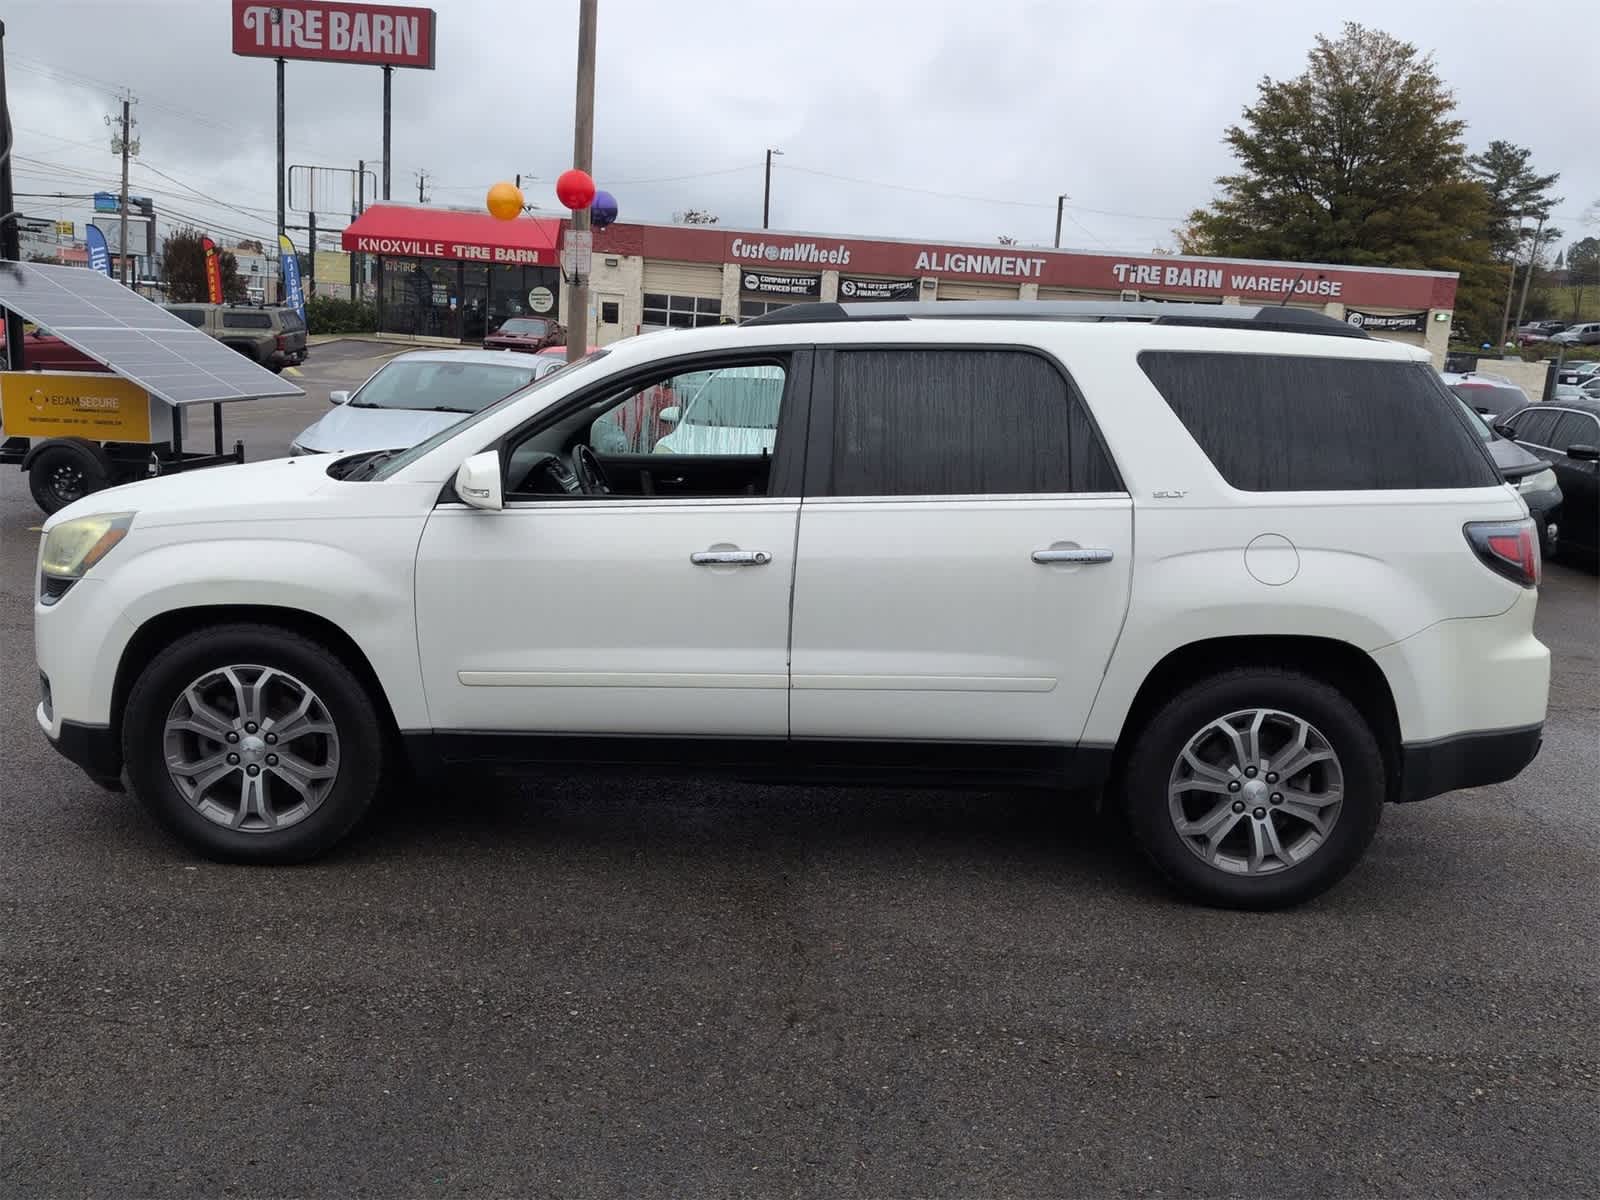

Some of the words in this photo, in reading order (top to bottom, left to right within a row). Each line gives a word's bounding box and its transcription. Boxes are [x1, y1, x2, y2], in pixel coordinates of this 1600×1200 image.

[329, 11, 419, 56] BARN
[358, 237, 444, 256] KNOXVILLE
[495, 247, 539, 263] BARN
[914, 251, 1047, 277] ALIGNMENT
[760, 275, 791, 284] COMPANY
[760, 284, 791, 292] SERVICED
[1165, 267, 1223, 288] BARN
[1231, 275, 1343, 296] WAREHOUSE
